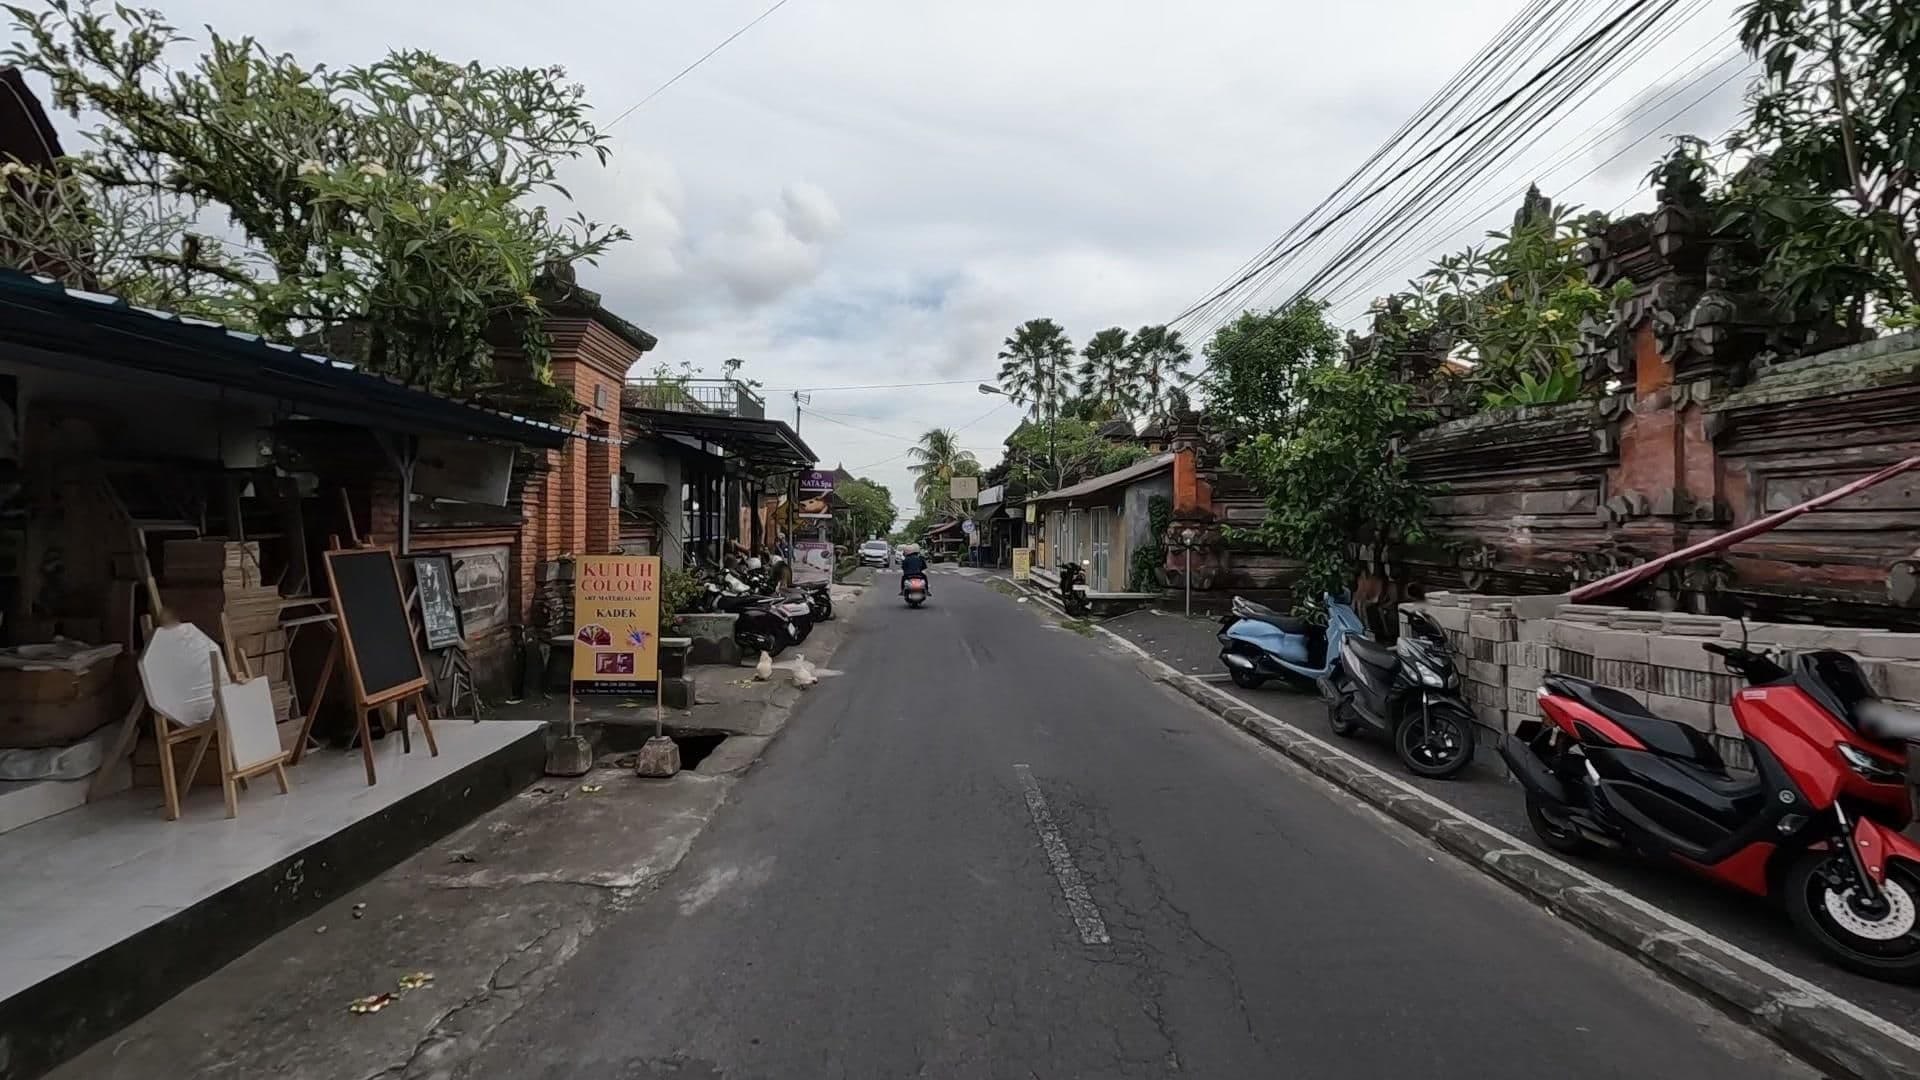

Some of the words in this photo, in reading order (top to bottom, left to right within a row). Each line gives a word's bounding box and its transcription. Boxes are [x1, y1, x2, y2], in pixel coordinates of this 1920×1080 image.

[583, 563, 652, 577] KUTUH
[581, 579, 652, 592] COLOUR
[596, 608, 637, 618] KADEK
